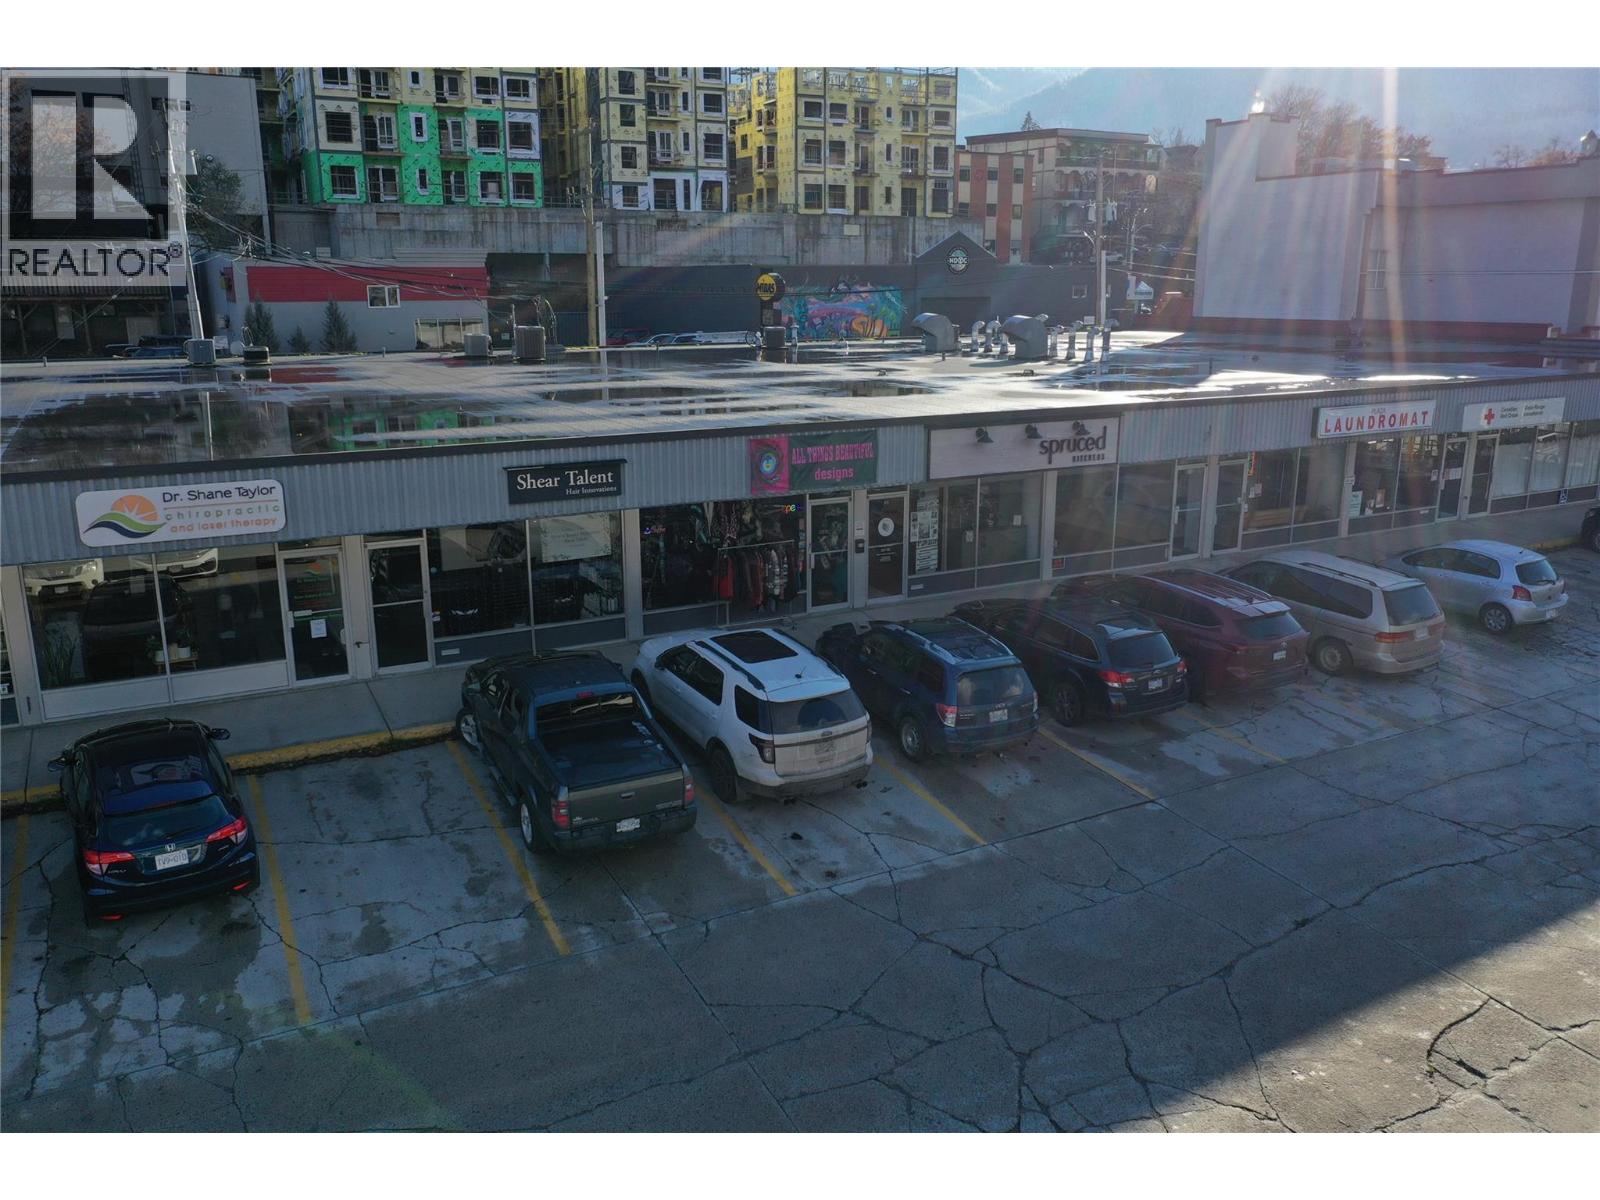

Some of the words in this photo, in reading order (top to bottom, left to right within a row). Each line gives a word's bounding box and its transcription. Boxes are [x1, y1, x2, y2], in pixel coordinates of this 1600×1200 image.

[1324, 410, 1429, 433] LAUNDROMAT
[791, 447, 807, 464] ALL
[807, 445, 833, 463] THINGS
[835, 442, 875, 461] BEAUTIFUL
[1039, 425, 1107, 464] spruced
[516, 473, 560, 490] Shear
[565, 469, 614, 486] Talent
[815, 466, 854, 481] designs
[162, 491, 183, 503] Dr.
[187, 487, 232, 501] Shane
[236, 485, 276, 499] Taylor
[566, 488, 580, 496] Hair
[581, 485, 617, 494] Innovations
[164, 504, 280, 521] chiropractic
[170, 522, 194, 533] and
[198, 520, 227, 532] laser
[231, 517, 277, 530] therapy
